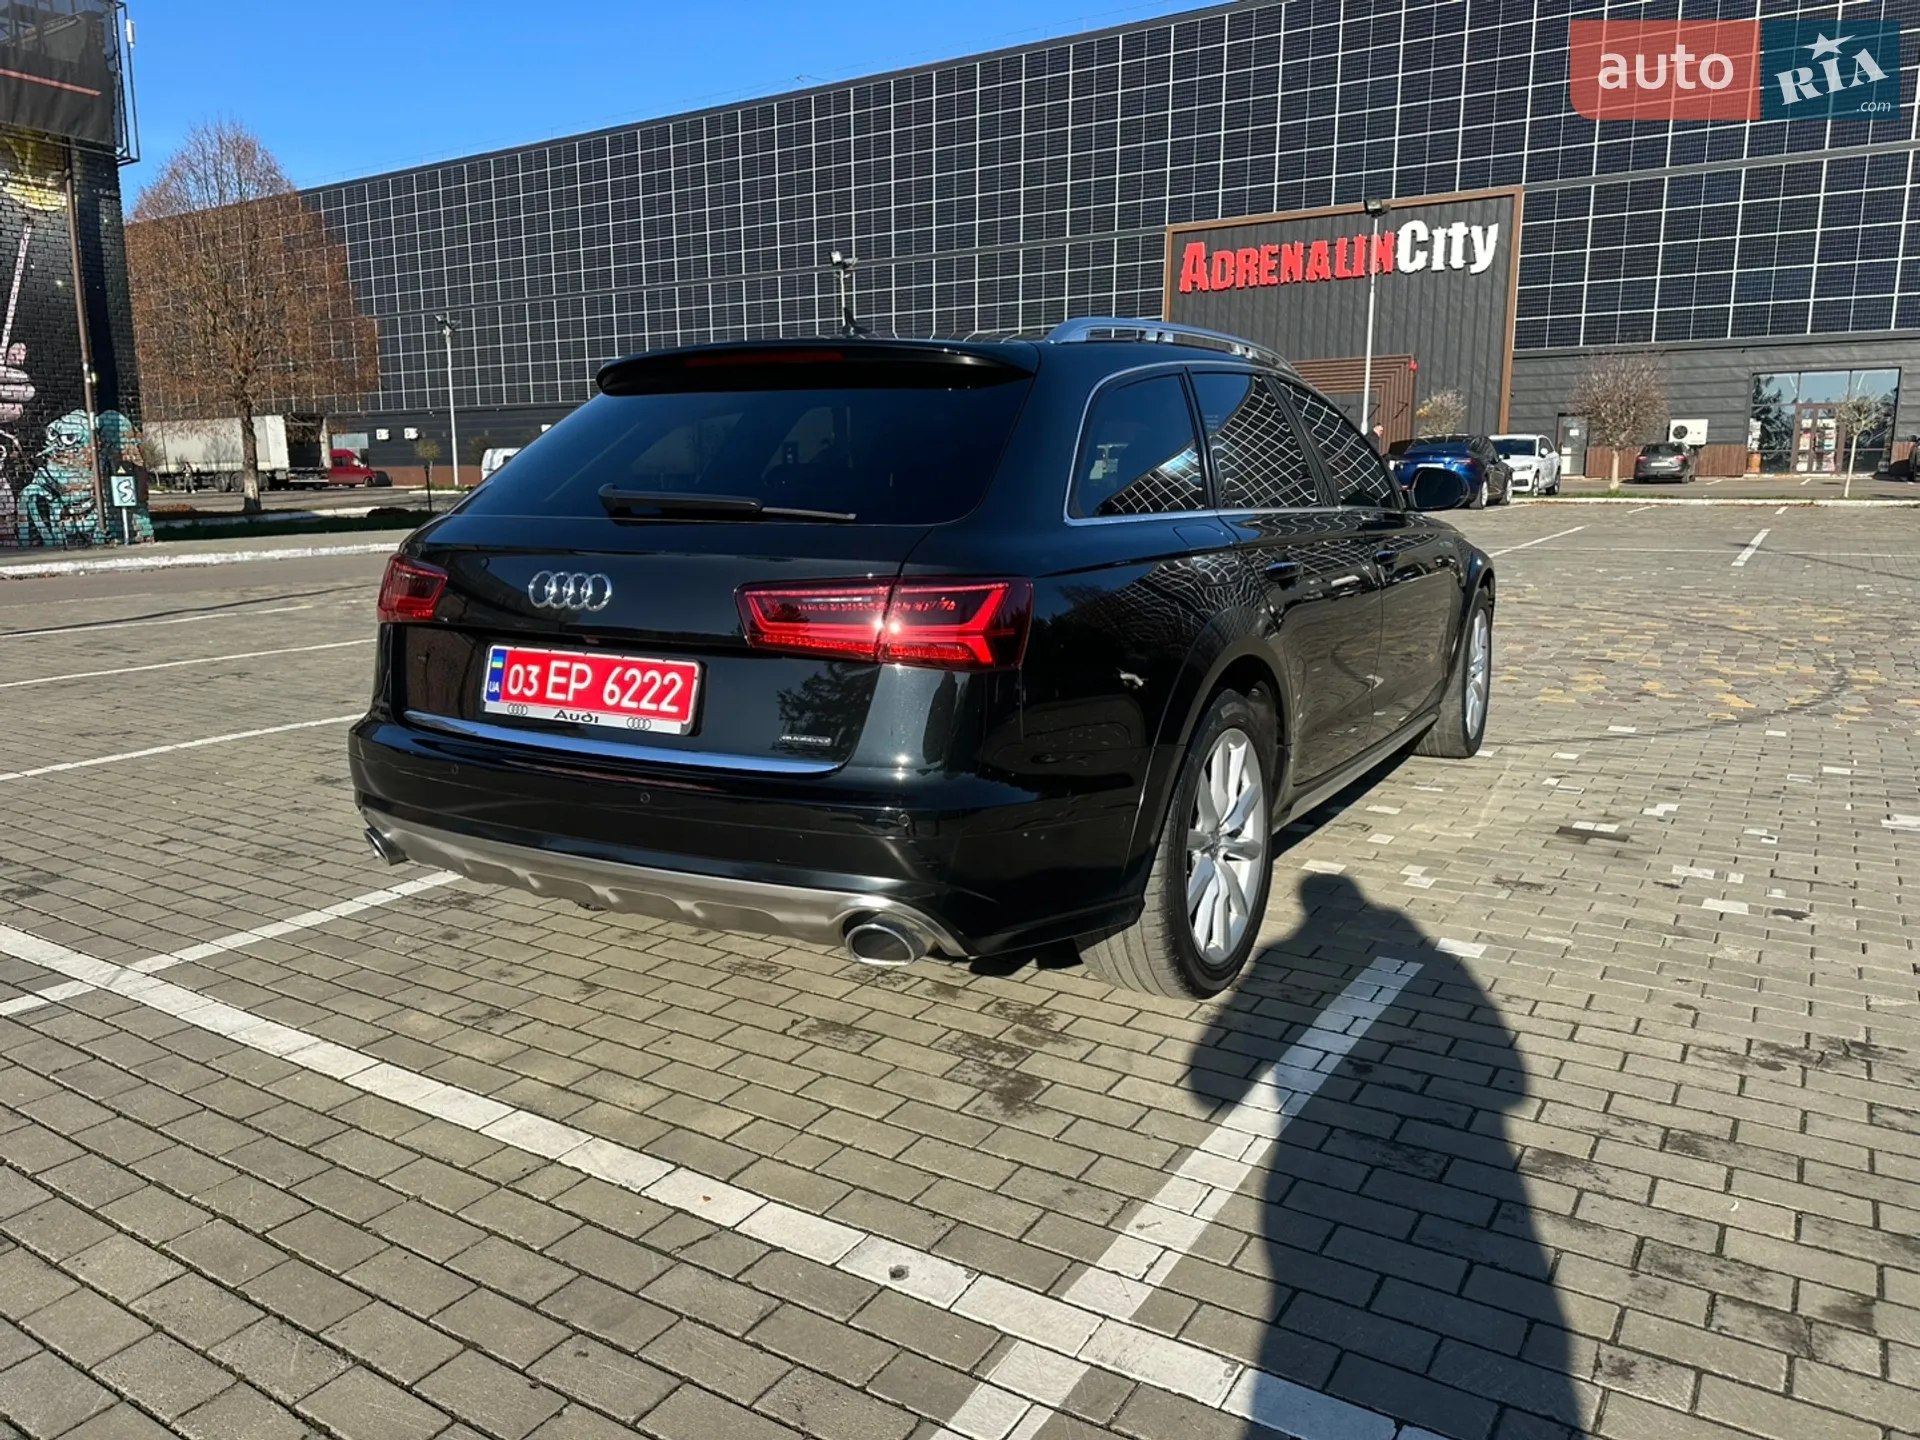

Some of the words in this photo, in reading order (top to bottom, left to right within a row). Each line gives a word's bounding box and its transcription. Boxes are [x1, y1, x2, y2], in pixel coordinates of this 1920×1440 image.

[488, 680, 500, 693] UA
[507, 663, 540, 697] 03
[546, 660, 593, 701] EP
[602, 667, 683, 713] 6222
[554, 709, 599, 724] Audi
